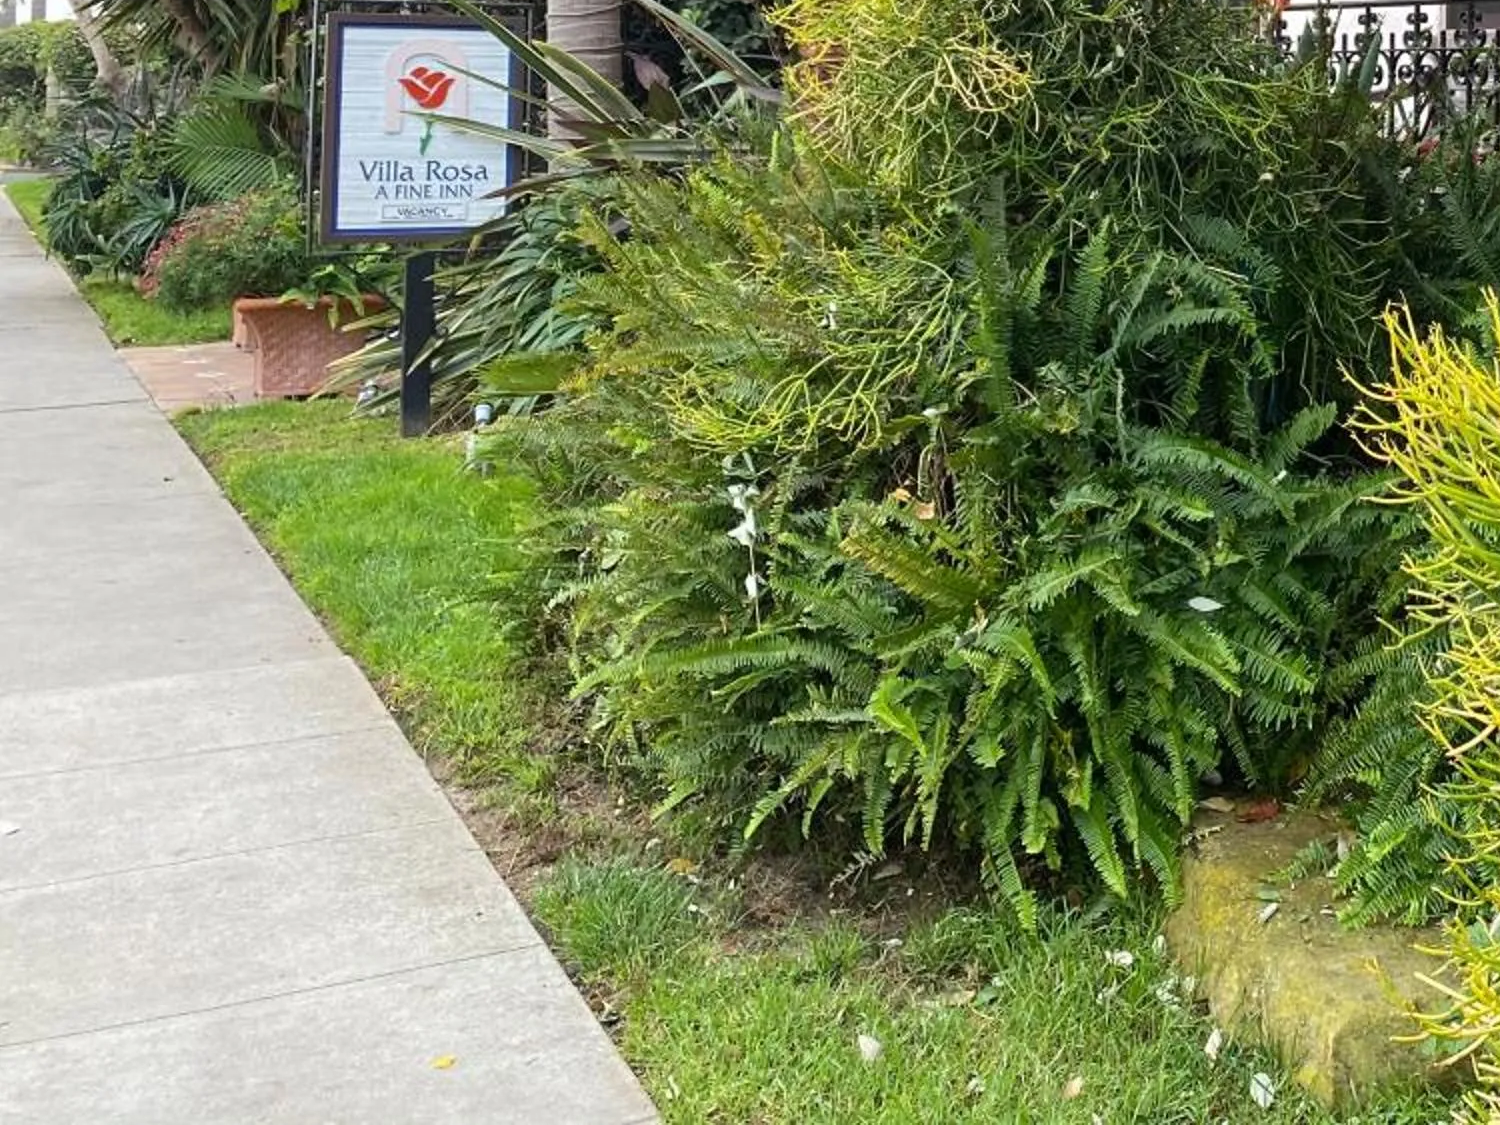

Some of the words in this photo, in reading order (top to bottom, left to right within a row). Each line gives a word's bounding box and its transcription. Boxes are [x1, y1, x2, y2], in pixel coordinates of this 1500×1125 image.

[359, 160, 414, 182] Villa
[426, 160, 488, 182] Rosa
[374, 185, 389, 200] A
[395, 184, 432, 199] FINE
[439, 184, 473, 198] INN
[397, 206, 449, 217] VACANCY
